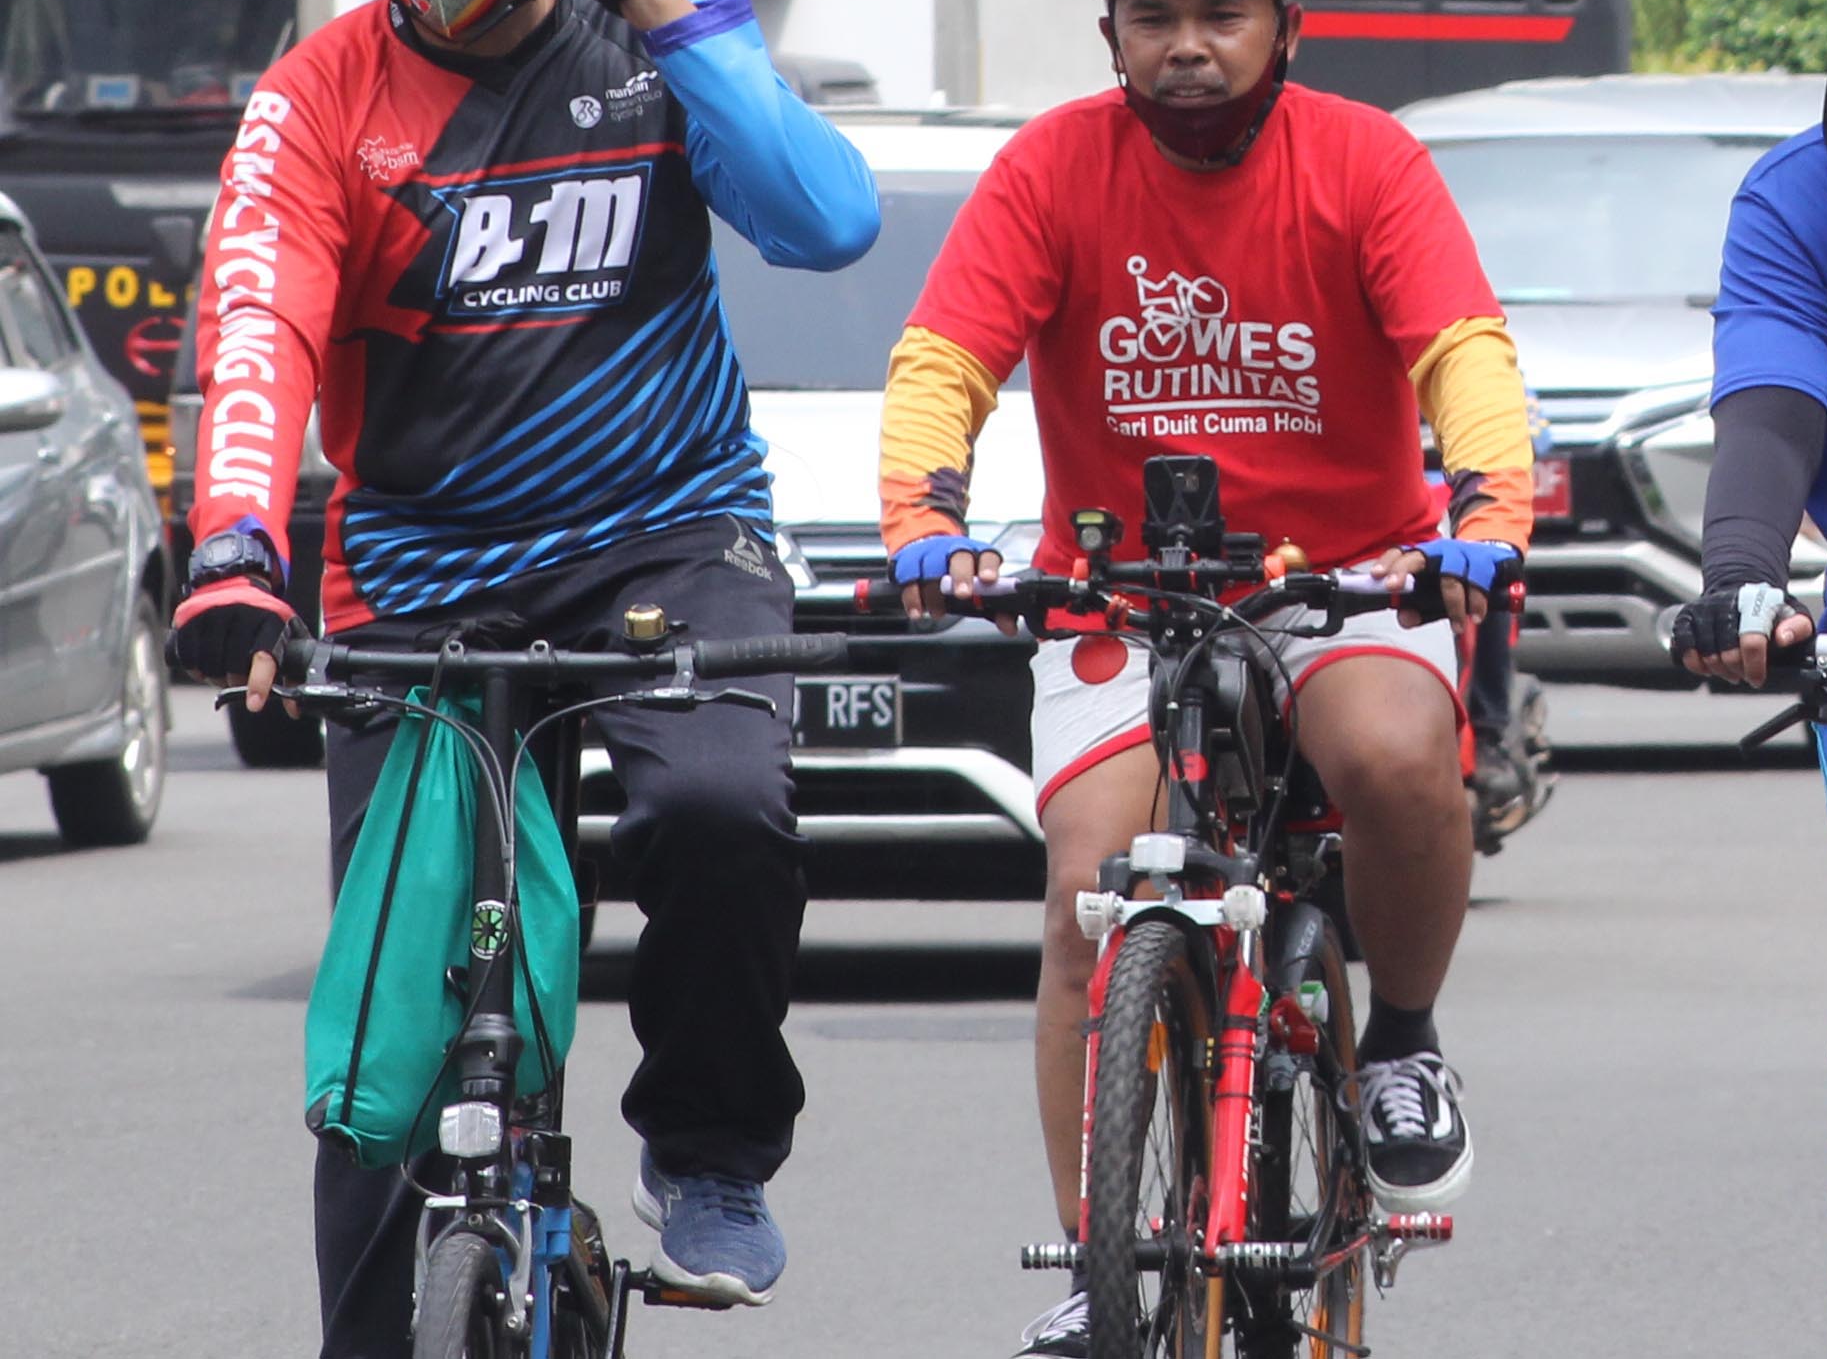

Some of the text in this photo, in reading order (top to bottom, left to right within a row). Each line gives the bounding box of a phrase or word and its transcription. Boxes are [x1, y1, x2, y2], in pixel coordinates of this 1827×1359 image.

[67, 264, 197, 308] POL
[212, 195, 280, 385] CYCLING
[463, 280, 622, 307] CYCLING CLUB
[1104, 363, 1321, 406] RUTINITAS
[1154, 414, 1198, 436] Duit
[1204, 412, 1267, 434] Cuma
[1274, 412, 1322, 435] Hobi
[724, 548, 773, 582] Reebok
[827, 684, 893, 728] RFS
